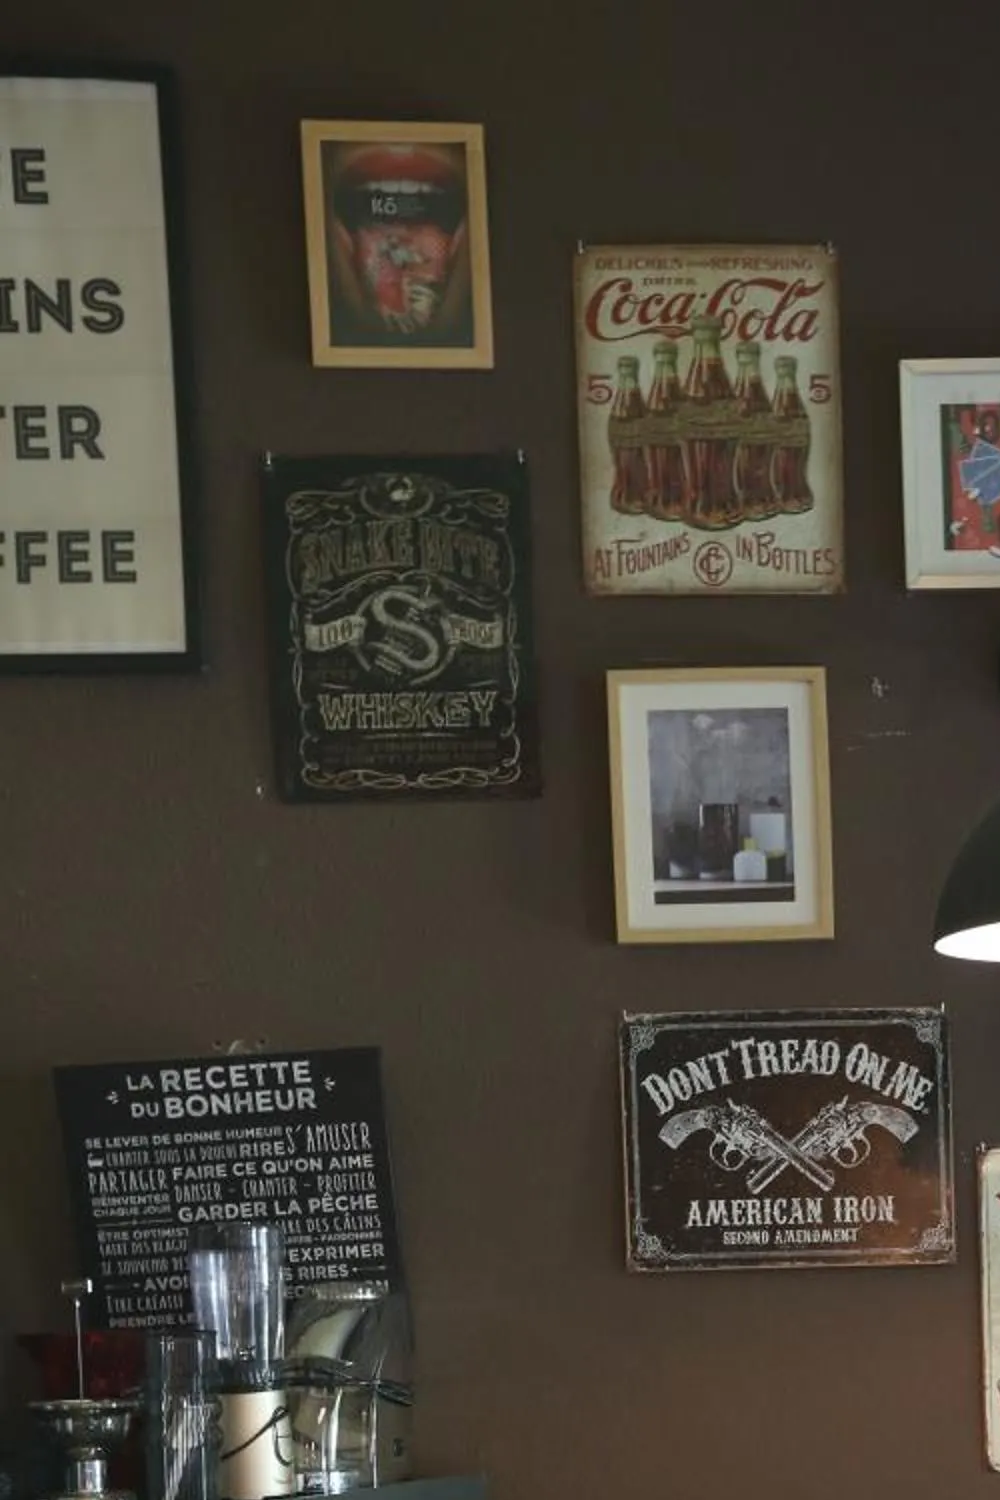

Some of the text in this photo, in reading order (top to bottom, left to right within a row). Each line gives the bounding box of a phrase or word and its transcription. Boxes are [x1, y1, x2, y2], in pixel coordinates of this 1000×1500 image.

[10, 149, 50, 205] E
[585, 278, 825, 342] Coca-Cola
[0, 405, 106, 459] ER
[735, 535, 755, 562] IN
[753, 532, 836, 576] BOTTLES
[317, 691, 499, 731] WHISKEY
[126, 1060, 313, 1092] LA RECETTE
[732, 1036, 841, 1080] TREAD
[845, 1043, 890, 1091] ON
[131, 1087, 317, 1119] DU BONHEUR
[105, 1135, 149, 1148] LEVER
[152, 1133, 171, 1145] DE
[174, 1131, 222, 1144] BONNE
[225, 1126, 283, 1140] HUMEUR
[239, 1141, 286, 1159] RIRE
[88, 1168, 168, 1194] PARTAGER
[172, 1153, 375, 1181] FAIRE CE QU'ON AIME
[174, 1171, 377, 1203] DANSER CHANTER PROFITER
[177, 1192, 379, 1223] GARDER LA PÊCHE
[305, 1217, 329, 1233] DES
[333, 1211, 382, 1232] CÂLINS
[686, 1196, 898, 1228] AMERICAN IRON
[723, 1226, 861, 1246] SECOND AMENDMENT
[143, 1275, 189, 1293] AVOI
[297, 1264, 350, 1281] RIRES
